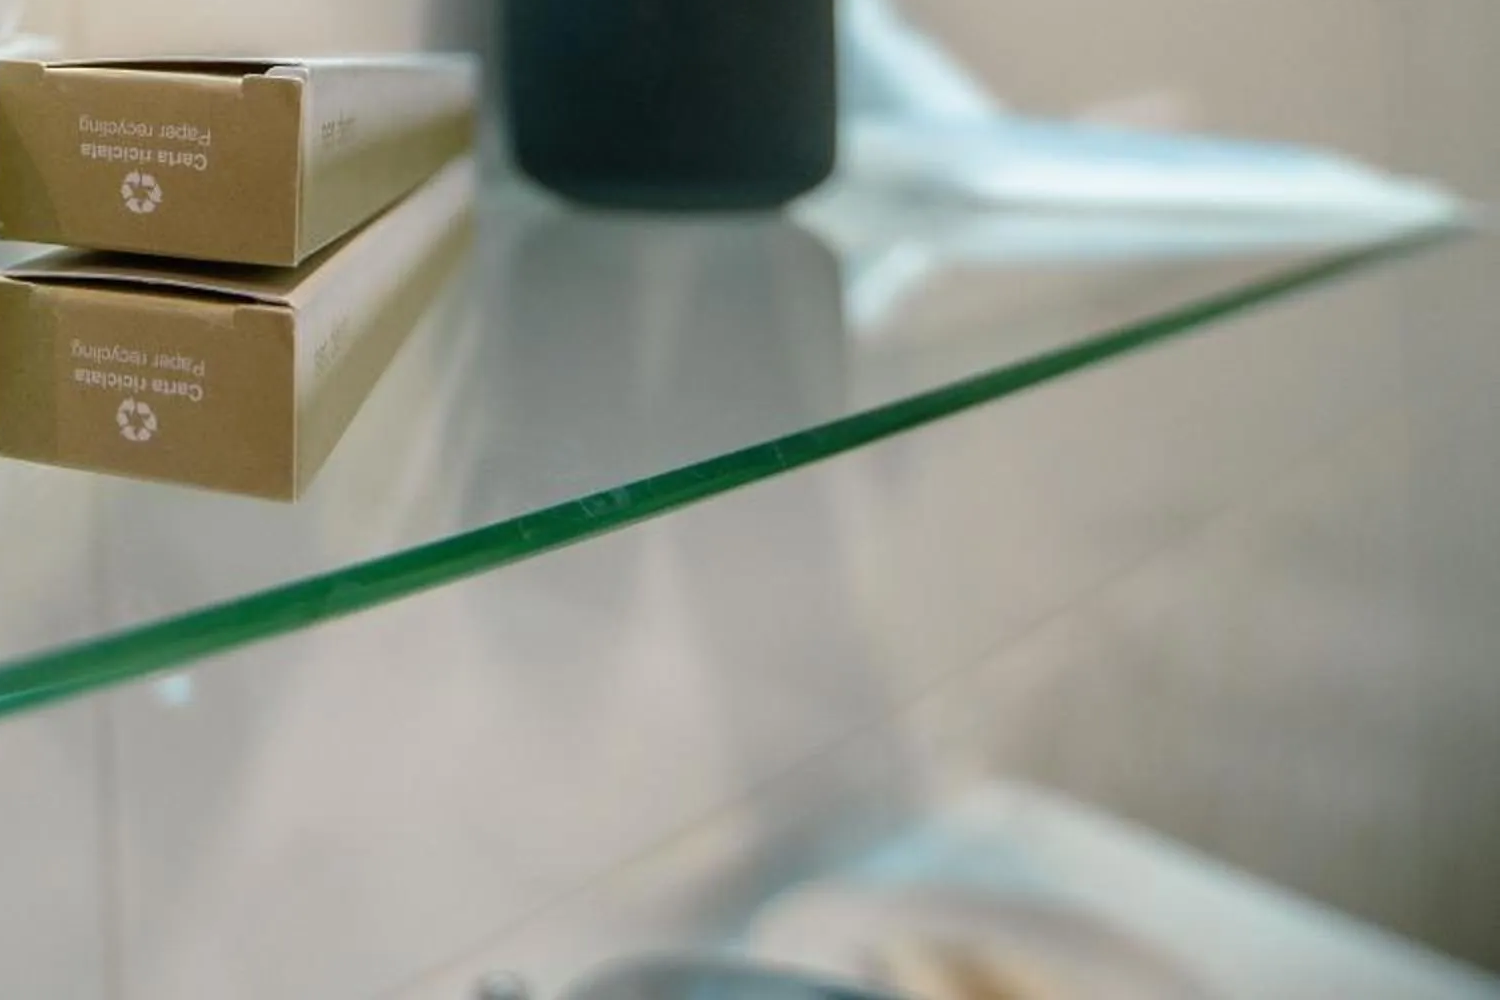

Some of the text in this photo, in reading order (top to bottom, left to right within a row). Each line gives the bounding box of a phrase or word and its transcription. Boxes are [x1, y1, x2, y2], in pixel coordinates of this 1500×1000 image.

[79, 114, 211, 147] Paper recycling
[80, 142, 208, 171] Carta riciclata
[70, 338, 206, 378] Paper recycling
[73, 367, 204, 402] Carta riciclata
